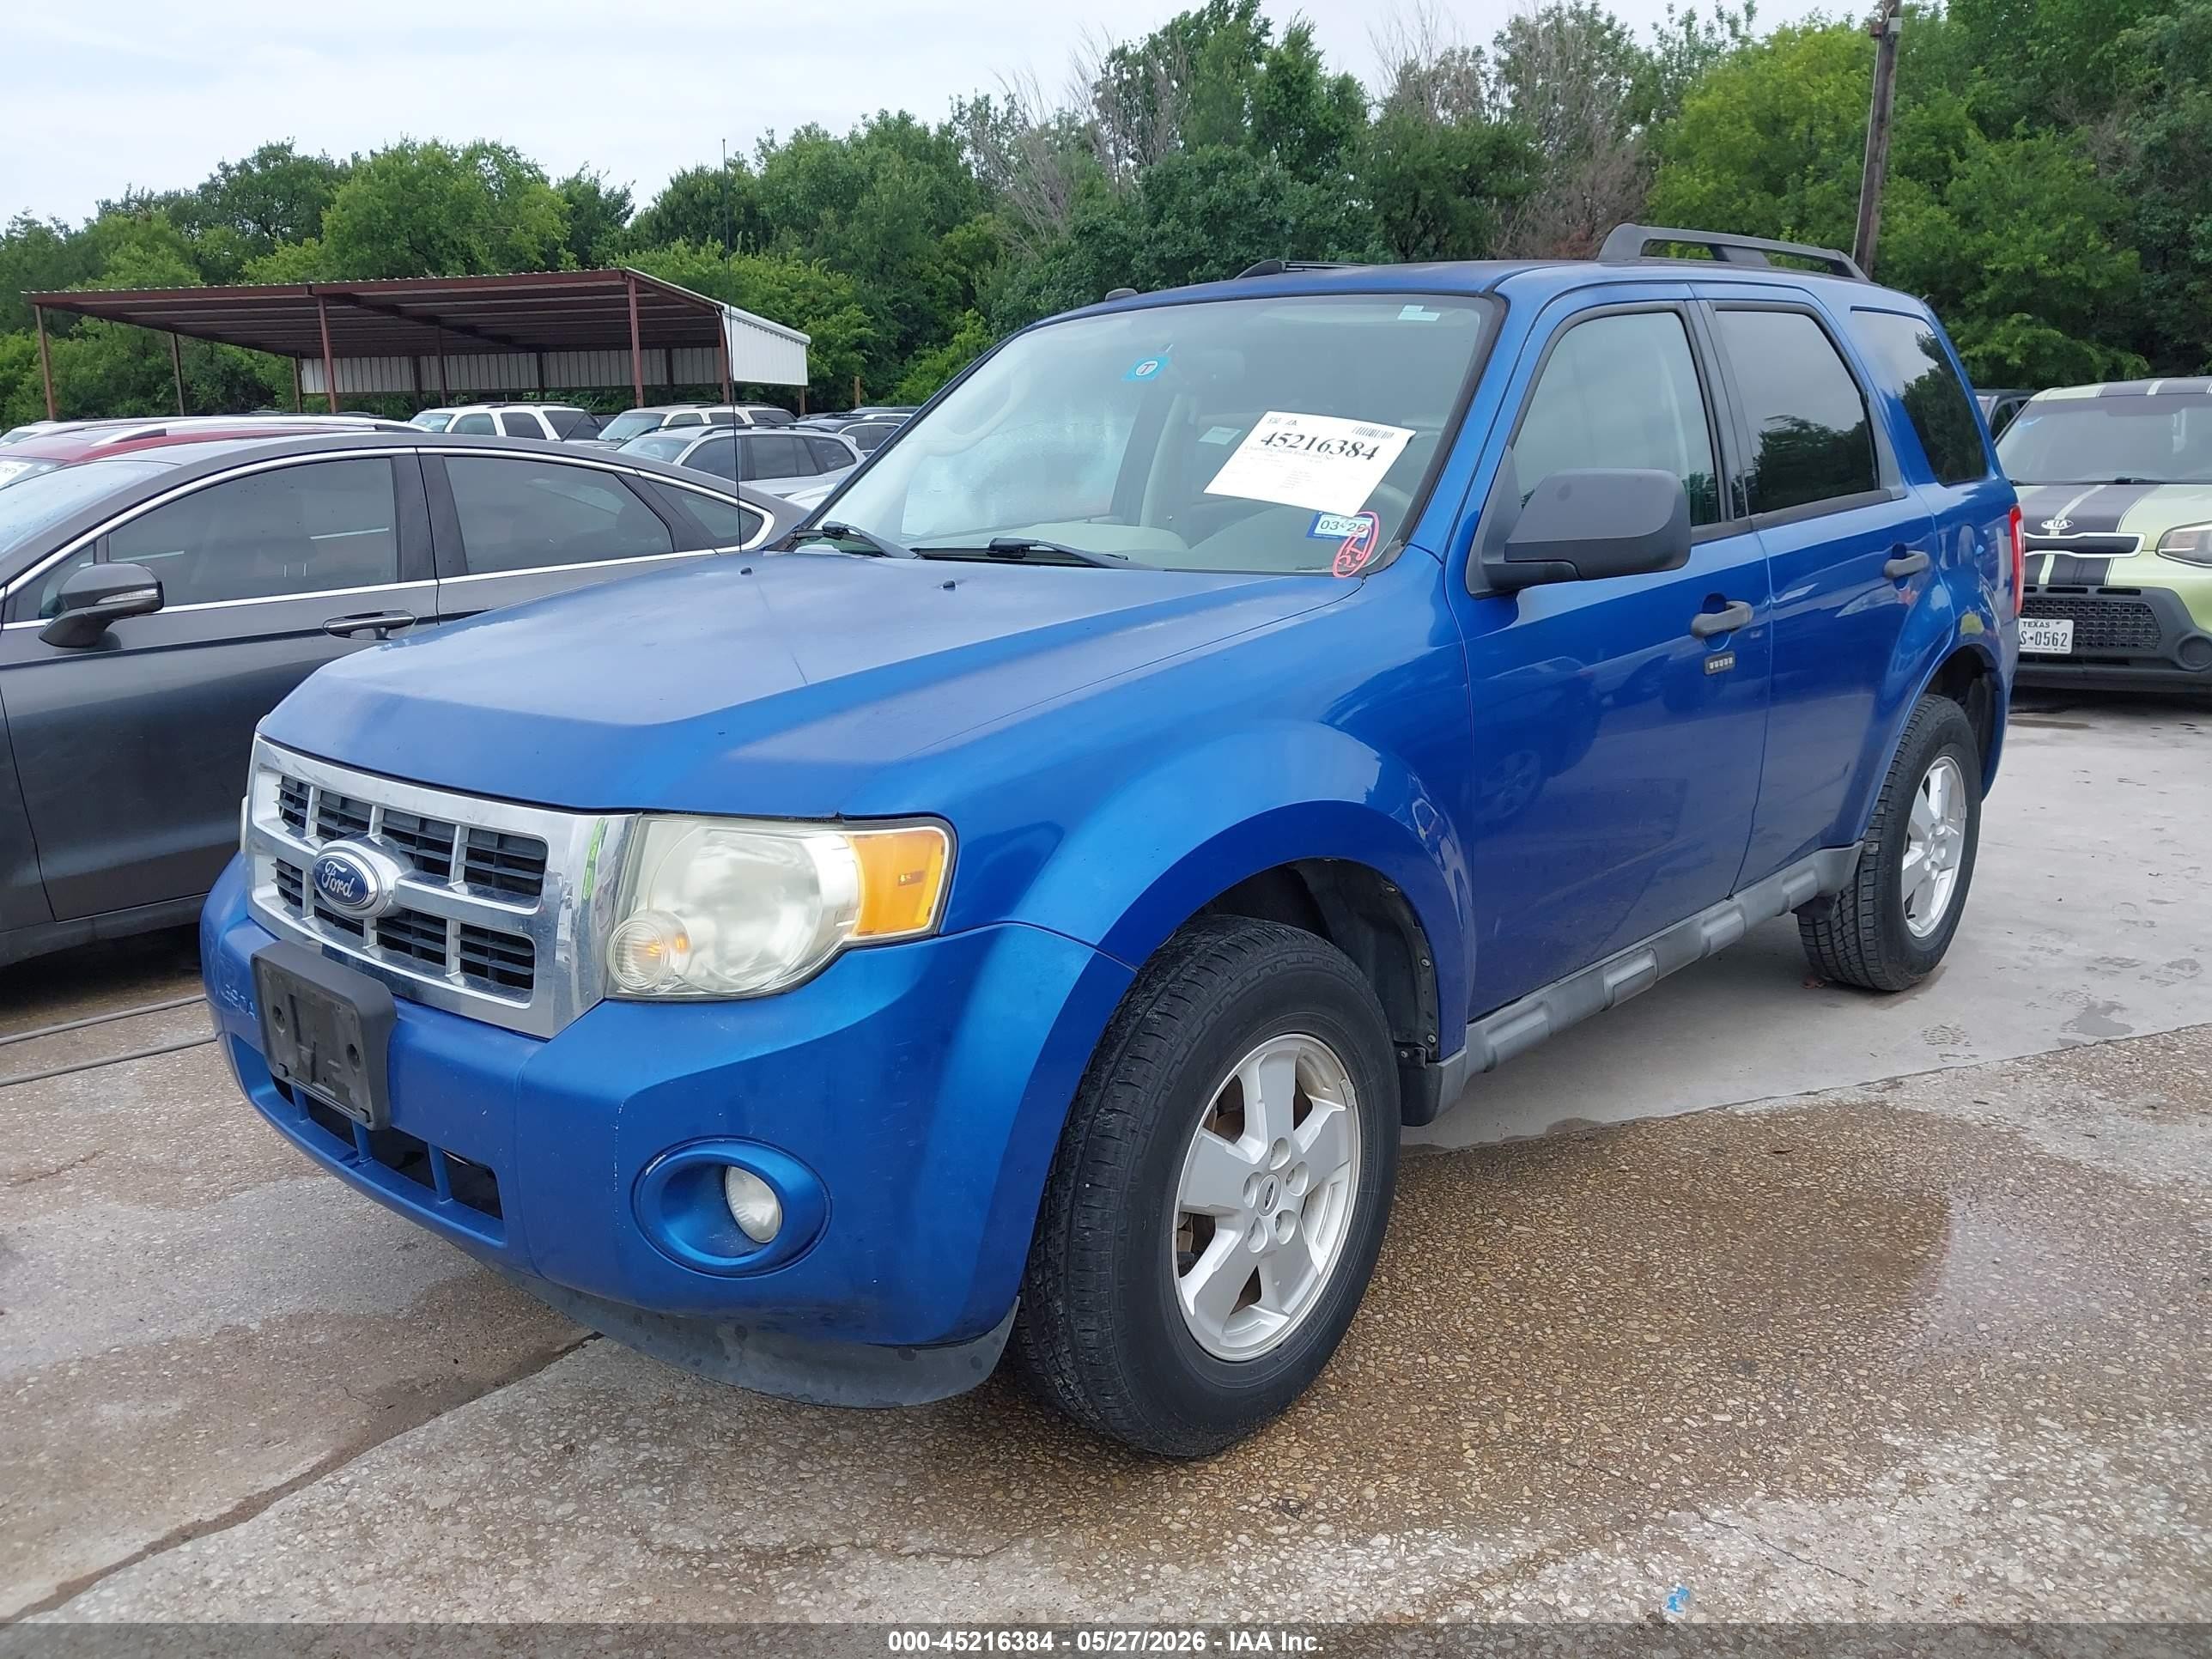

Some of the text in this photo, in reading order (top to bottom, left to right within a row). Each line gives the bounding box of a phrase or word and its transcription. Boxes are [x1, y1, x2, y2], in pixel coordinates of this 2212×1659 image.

[1261, 431, 1381, 461] 45216384
[2045, 519, 2069, 529] KIA
[321, 860, 355, 898] Ford
